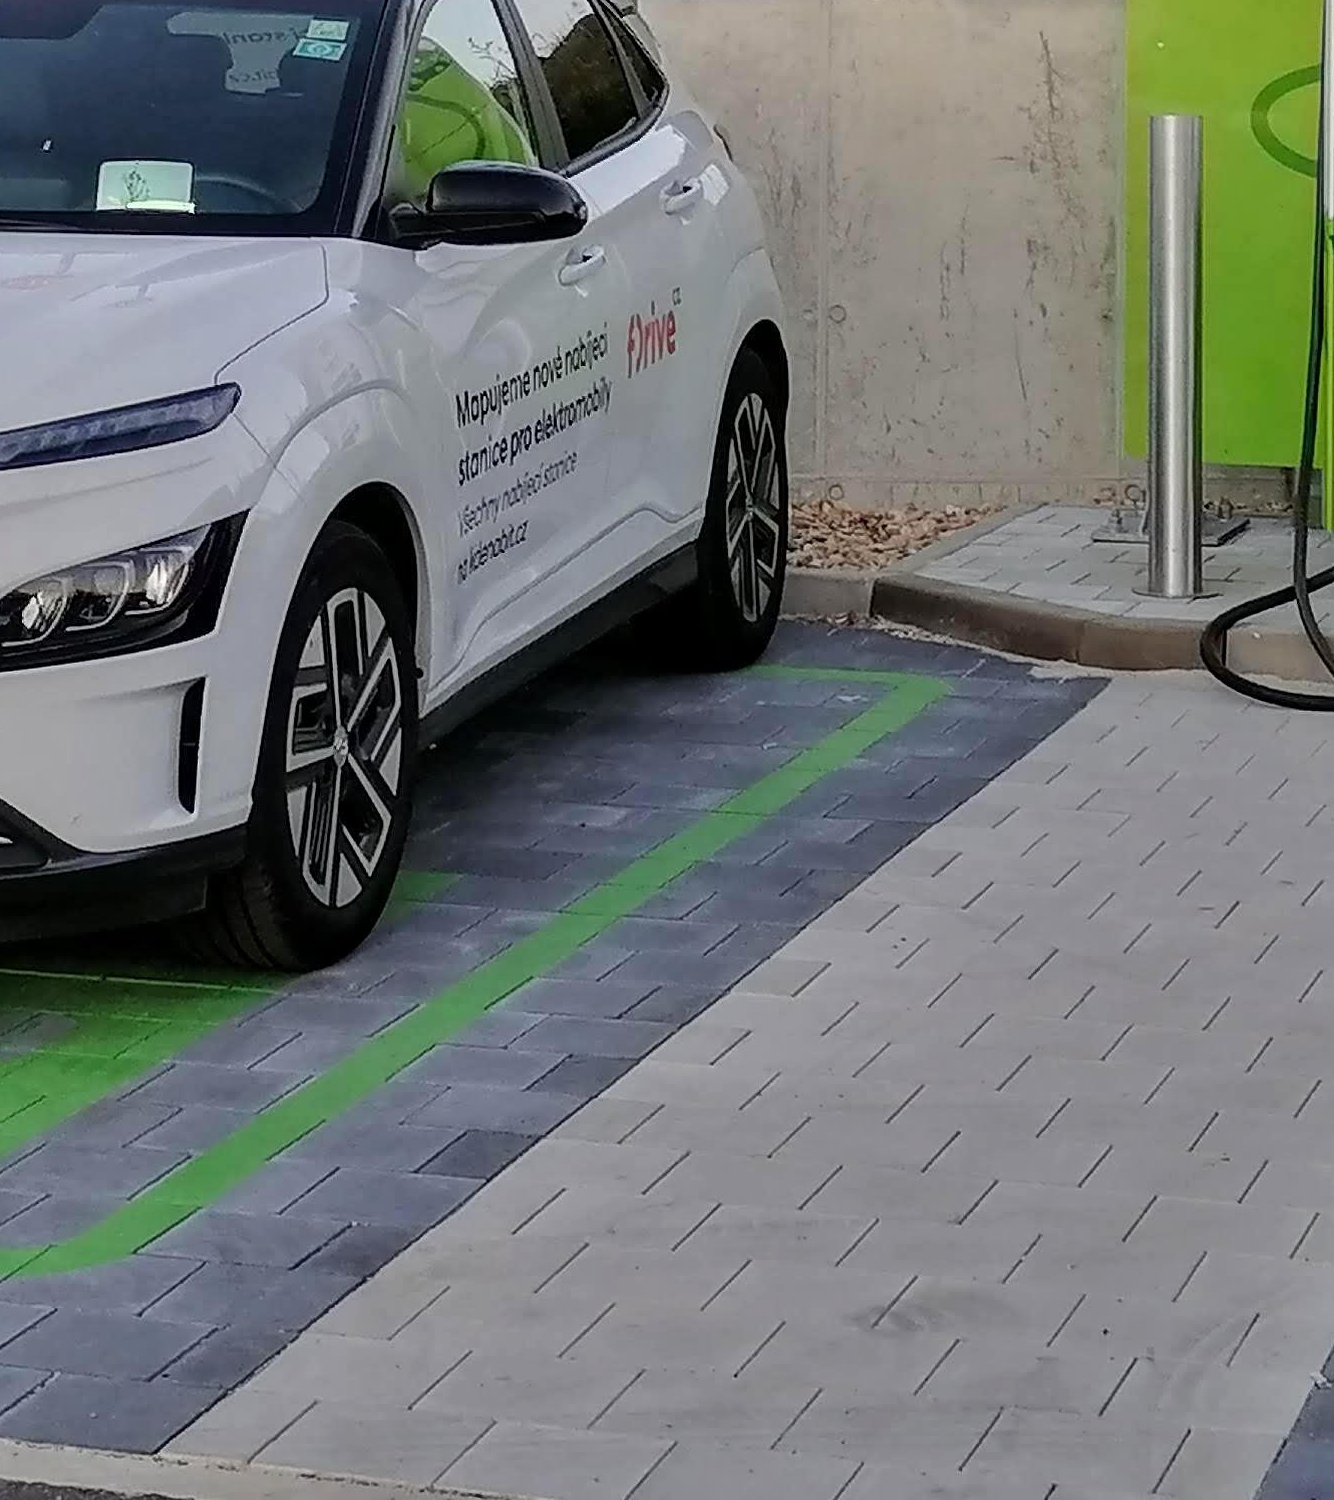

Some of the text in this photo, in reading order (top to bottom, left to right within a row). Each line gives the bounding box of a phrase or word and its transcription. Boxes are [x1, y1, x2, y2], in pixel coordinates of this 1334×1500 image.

[455, 373, 531, 428] Mapujeme
[533, 345, 563, 391] nové
[458, 376, 612, 486] stanice pro elektromobily
